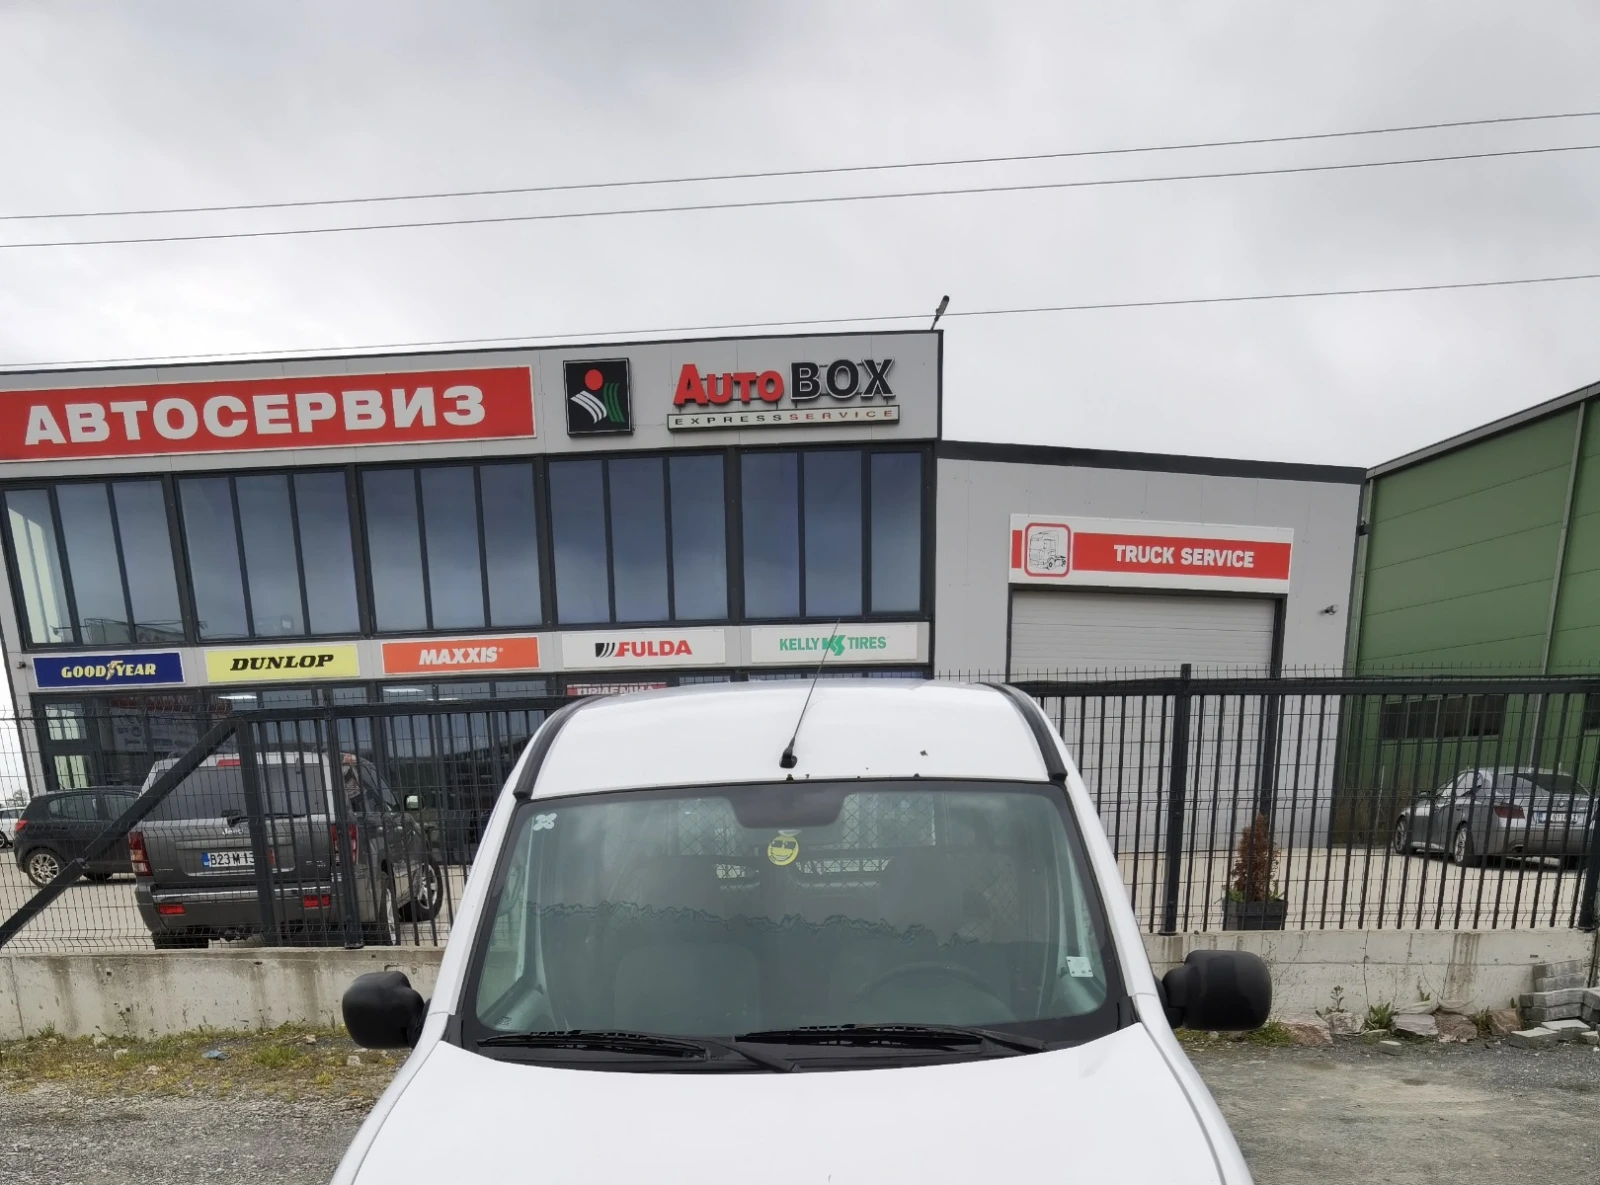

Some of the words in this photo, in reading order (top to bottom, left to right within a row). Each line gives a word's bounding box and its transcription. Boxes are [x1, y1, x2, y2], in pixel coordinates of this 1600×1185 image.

[790, 359, 896, 400] BOX
[24, 385, 486, 446] АВТОСЕРВИЗ
[1114, 544, 1175, 565] TRUCK
[1180, 548, 1255, 568] SERVICE
[614, 640, 693, 657] FULDA
[779, 637, 819, 651] KELLY
[847, 636, 887, 649] TIRES
[230, 654, 334, 671] DUNLOP
